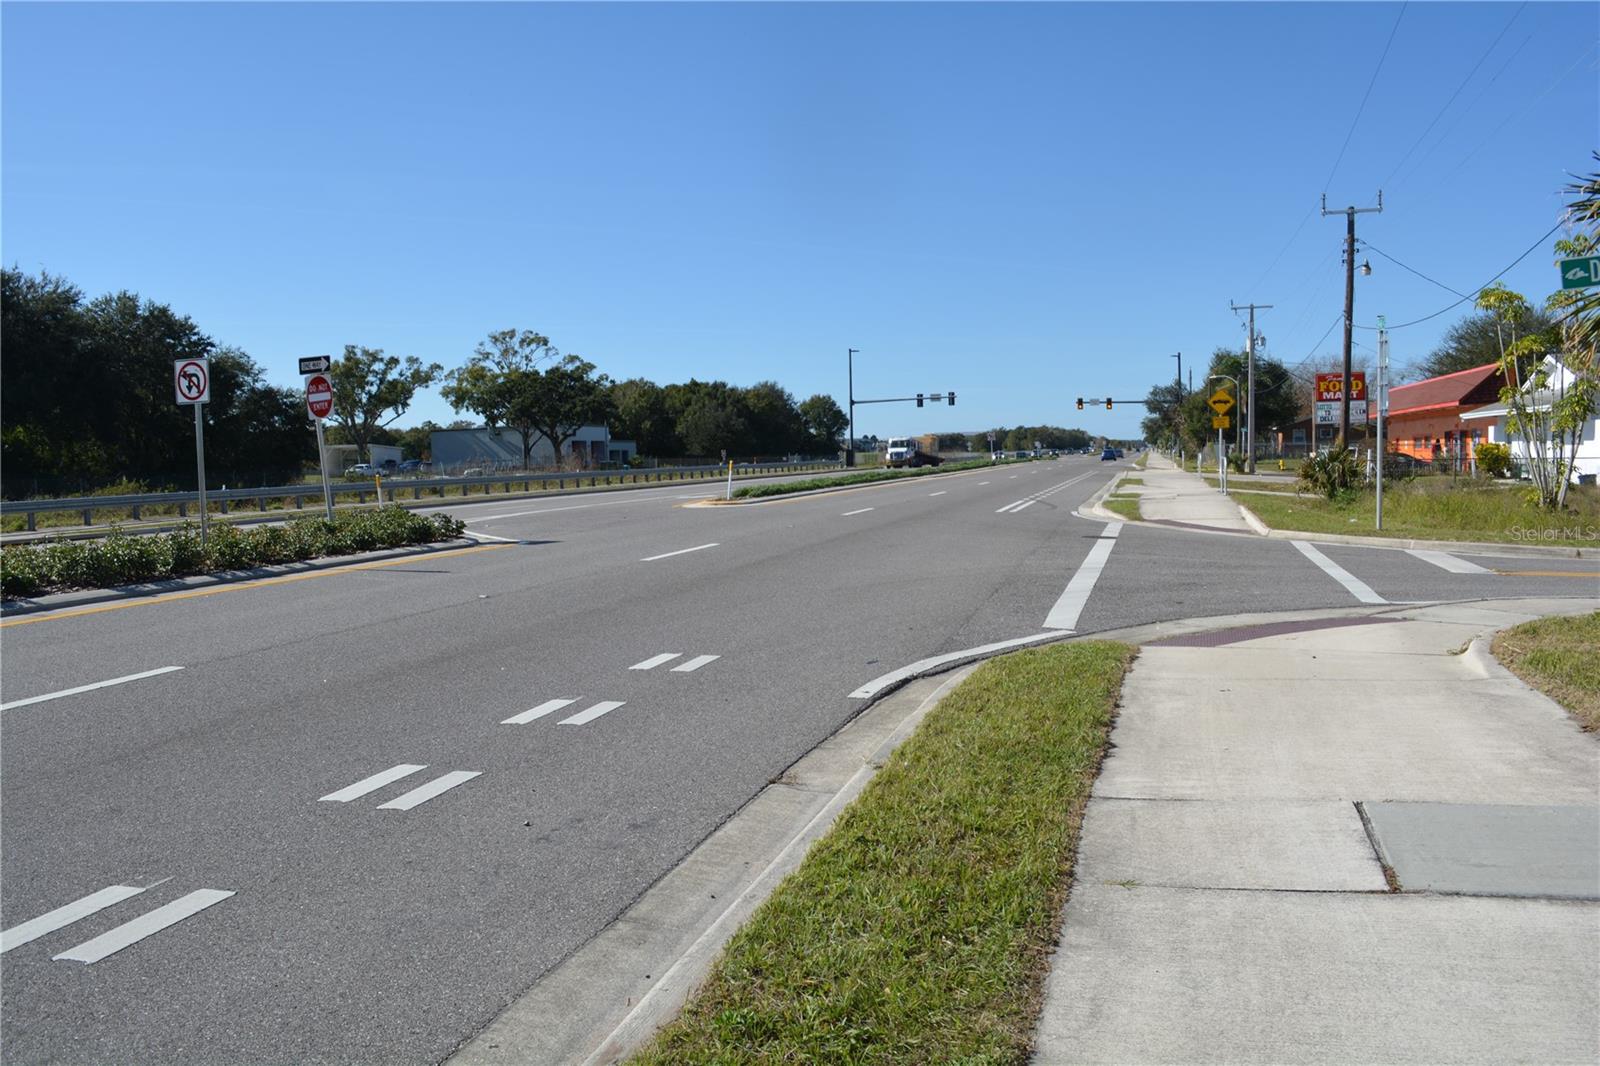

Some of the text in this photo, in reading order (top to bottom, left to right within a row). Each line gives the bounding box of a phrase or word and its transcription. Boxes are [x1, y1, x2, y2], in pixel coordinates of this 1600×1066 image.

[302, 360, 321, 370] ONE WAY
[309, 382, 328, 392] DO NOT
[1319, 380, 1363, 392] FOD
[1322, 391, 1358, 400] MAT
[313, 401, 329, 411] ENTER
